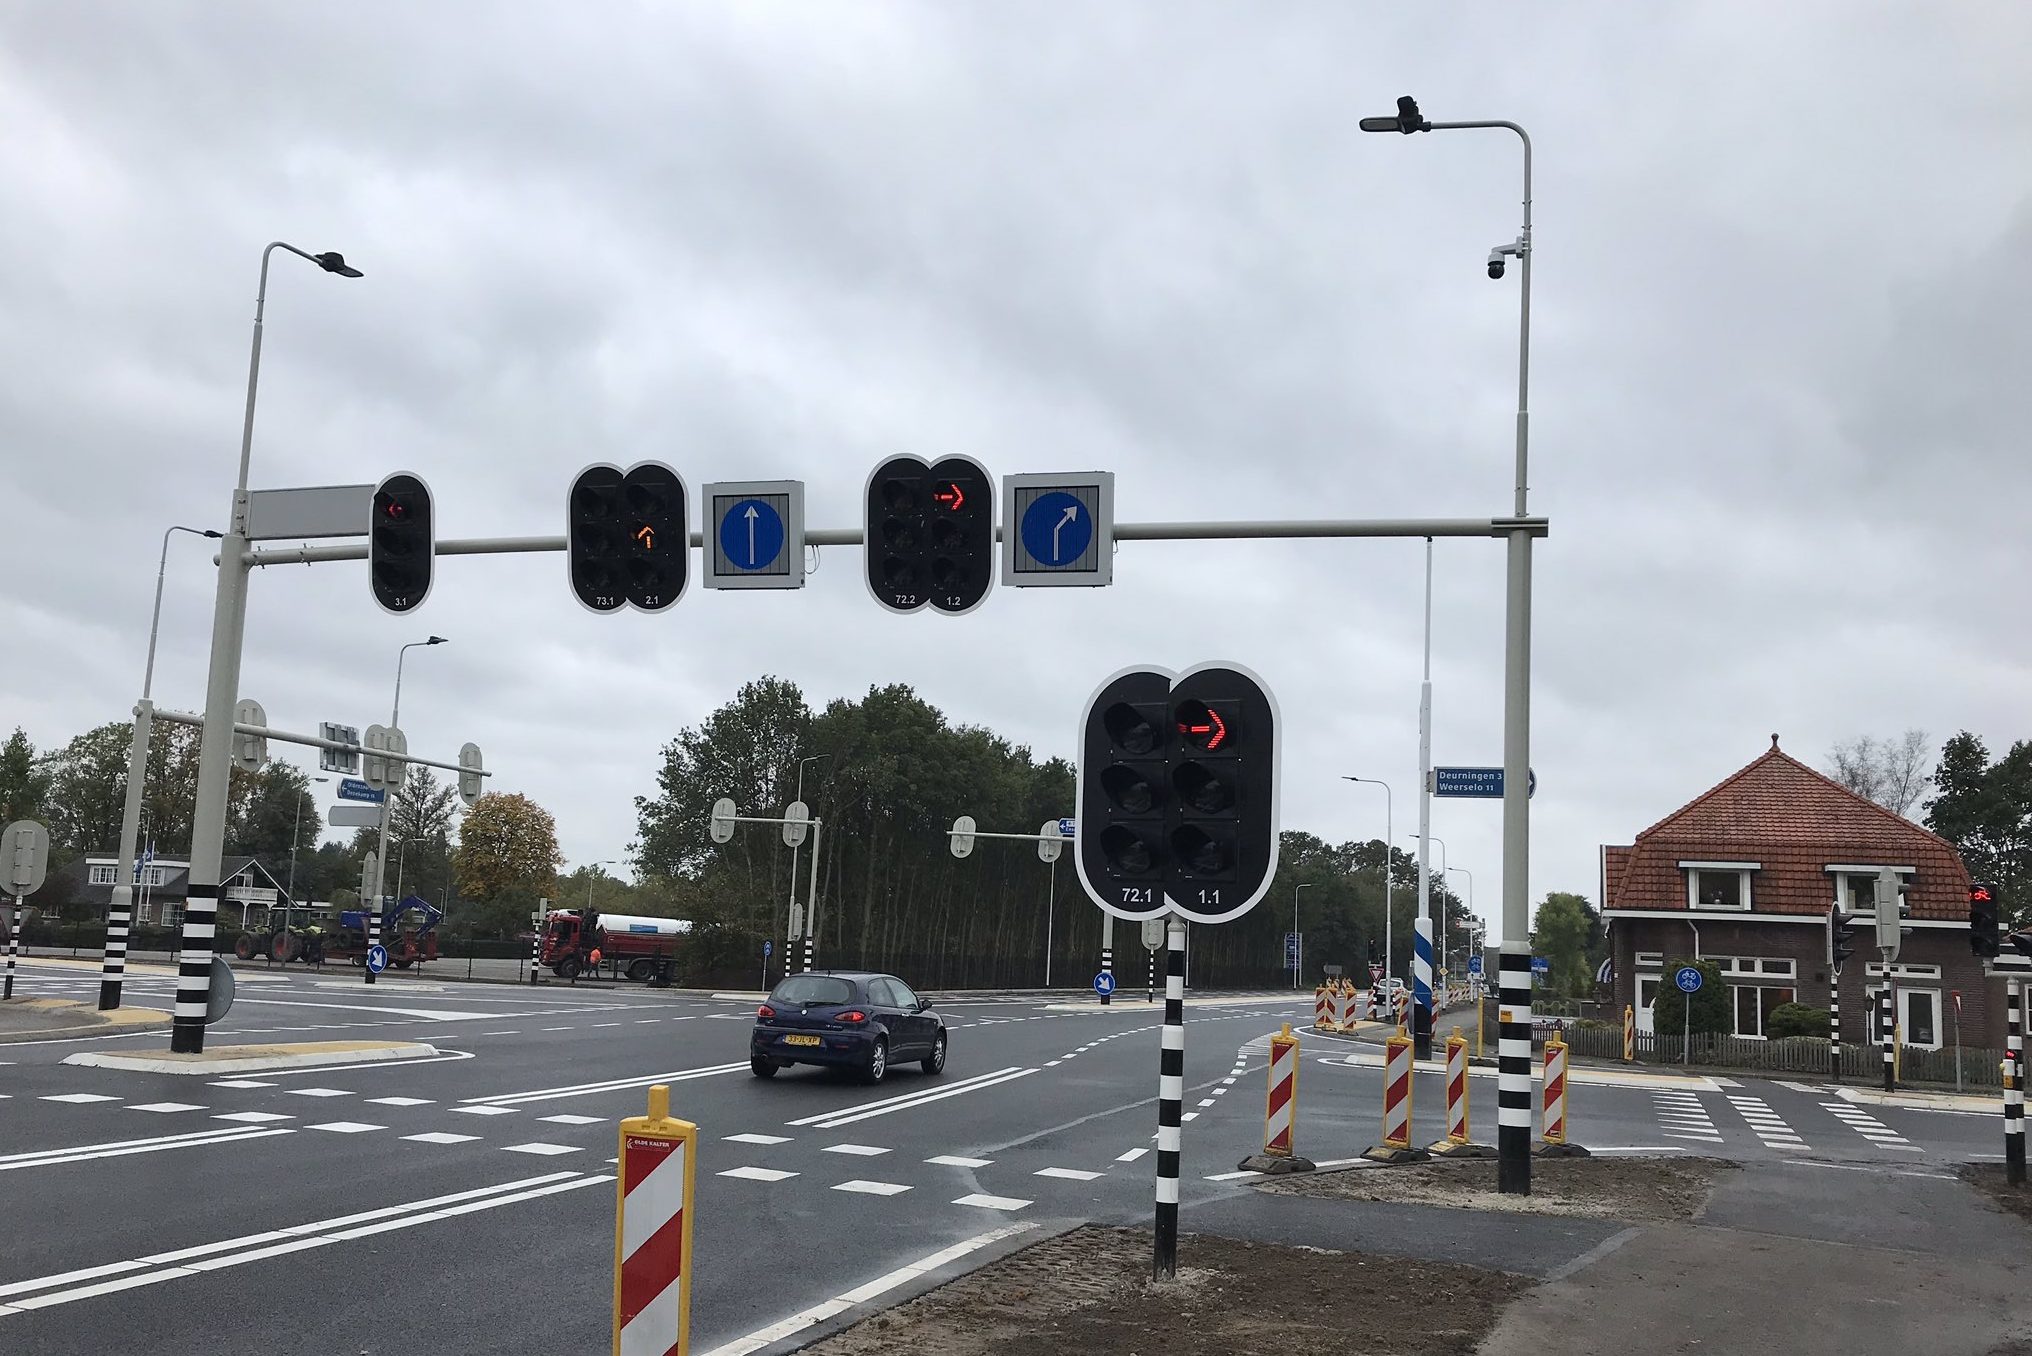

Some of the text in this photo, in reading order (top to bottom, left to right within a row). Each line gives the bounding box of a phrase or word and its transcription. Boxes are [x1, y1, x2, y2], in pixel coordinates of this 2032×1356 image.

[394, 598, 406, 606] 3.1
[596, 596, 614, 606] 73.1
[645, 596, 658, 604] 2.1
[896, 594, 916, 604] 72.2
[946, 596, 961, 605] 1.2
[1439, 772, 1494, 780] Deurningen
[1122, 888, 1152, 903] 72.1
[1198, 889, 1220, 904] 1.1
